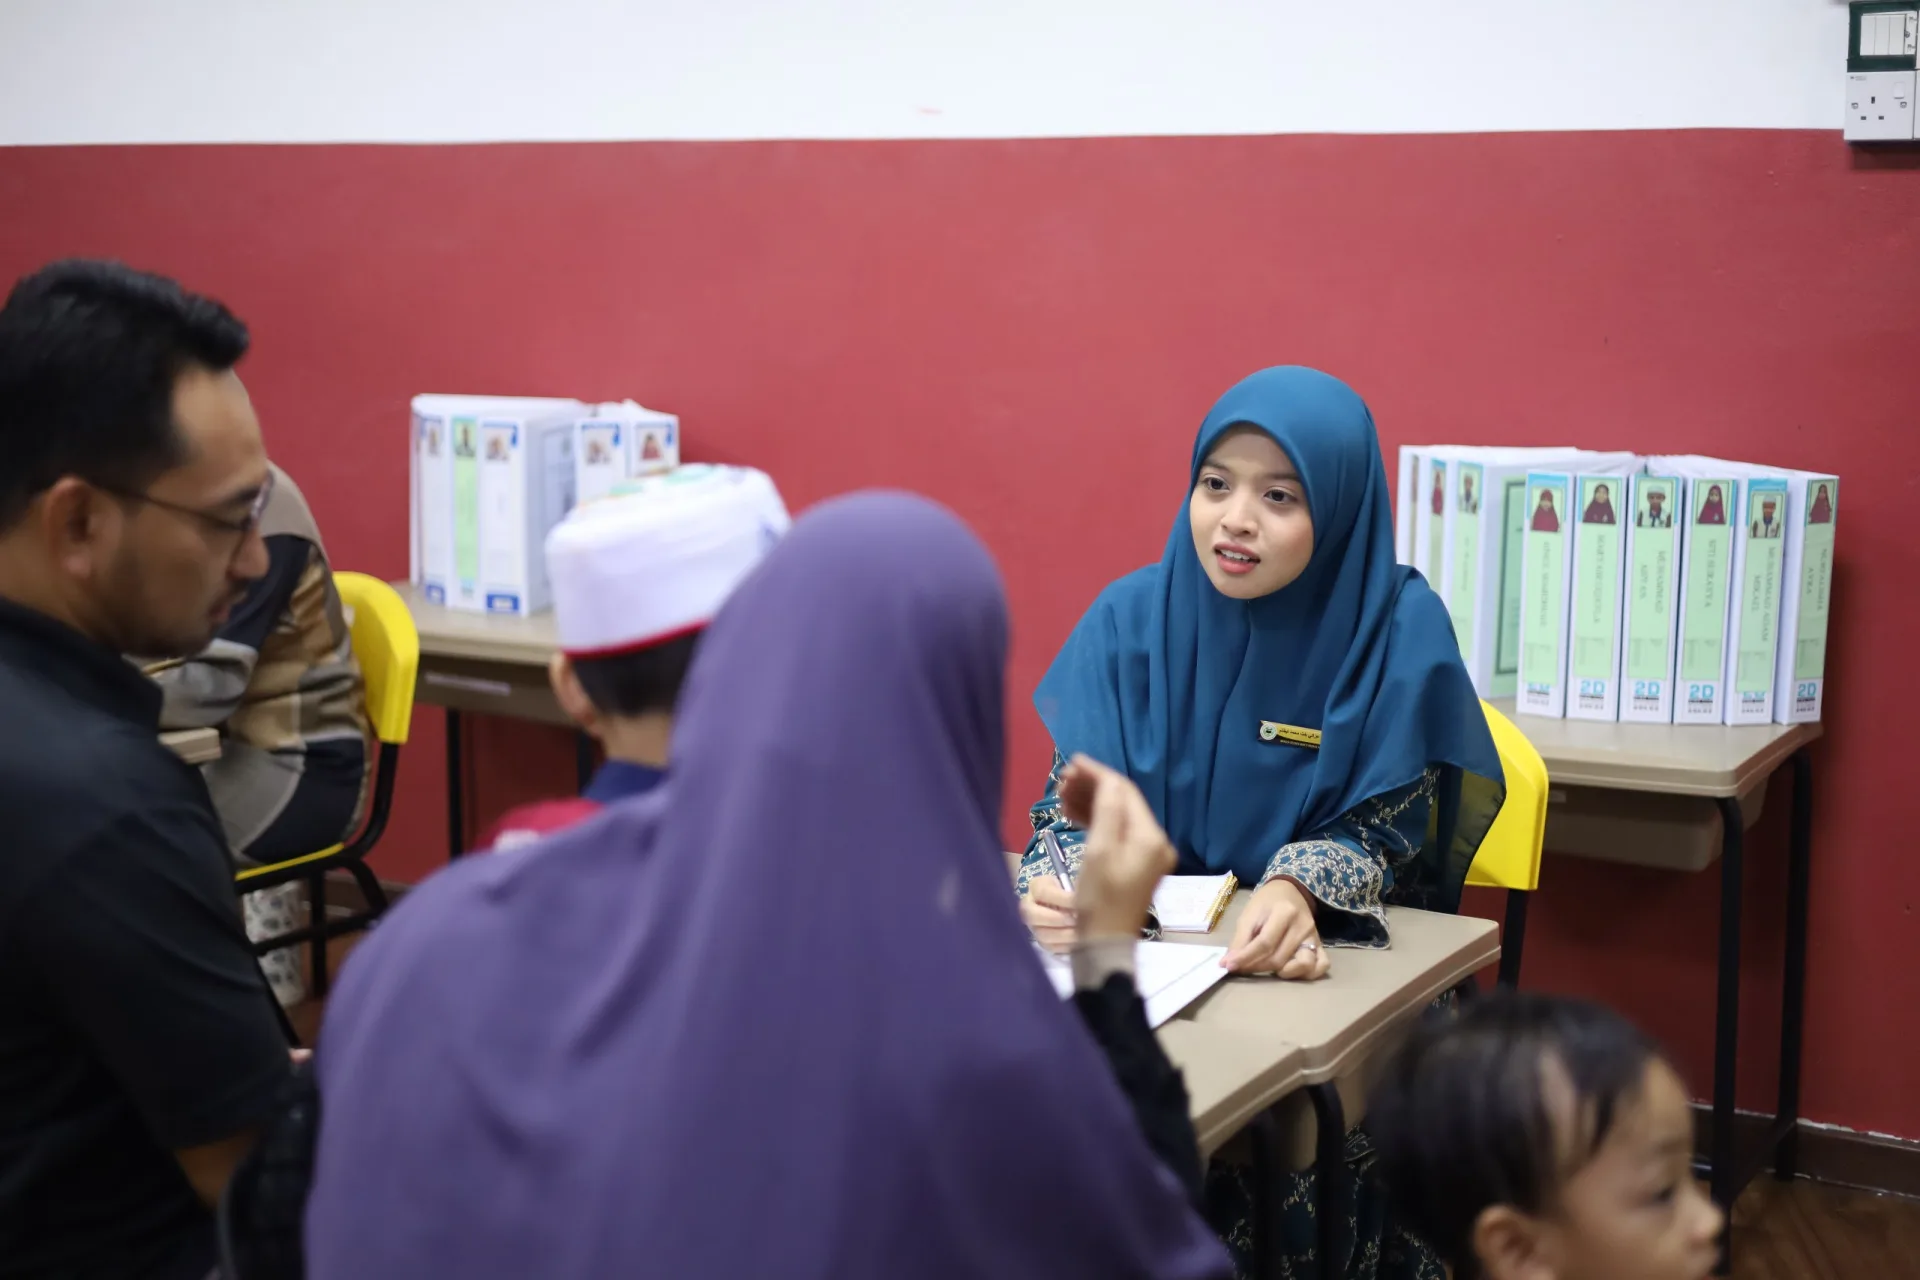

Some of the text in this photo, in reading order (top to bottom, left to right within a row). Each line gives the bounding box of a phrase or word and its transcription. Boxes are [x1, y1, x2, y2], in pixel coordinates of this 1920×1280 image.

[1580, 680, 1605, 695] 2D
[1635, 680, 1660, 696] 2D
[1689, 683, 1714, 699] 2D
[1798, 682, 1817, 697] 2D
